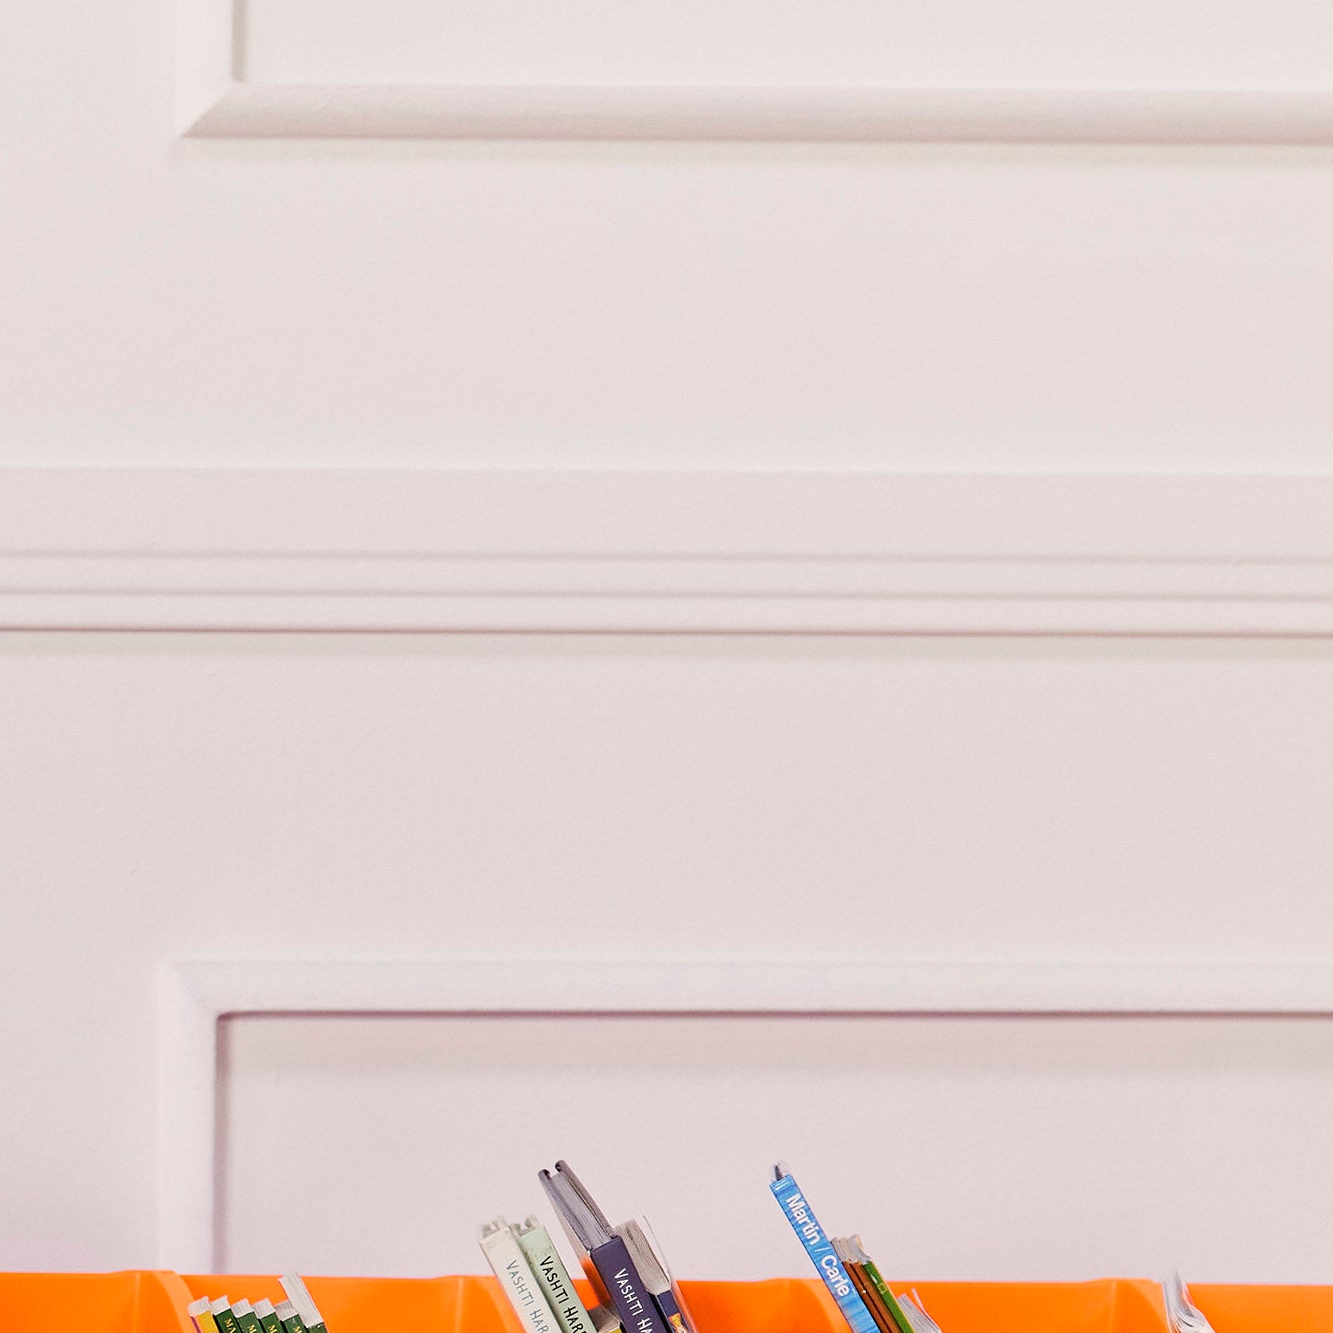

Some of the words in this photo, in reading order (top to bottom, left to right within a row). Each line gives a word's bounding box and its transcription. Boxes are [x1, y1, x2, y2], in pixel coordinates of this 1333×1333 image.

[786, 1193, 821, 1246] Martin
[820, 1254, 850, 1297] Carle
[505, 1260, 535, 1307] VASHTI
[540, 1256, 569, 1304] VASHTI
[614, 1268, 644, 1316] VASHTI
